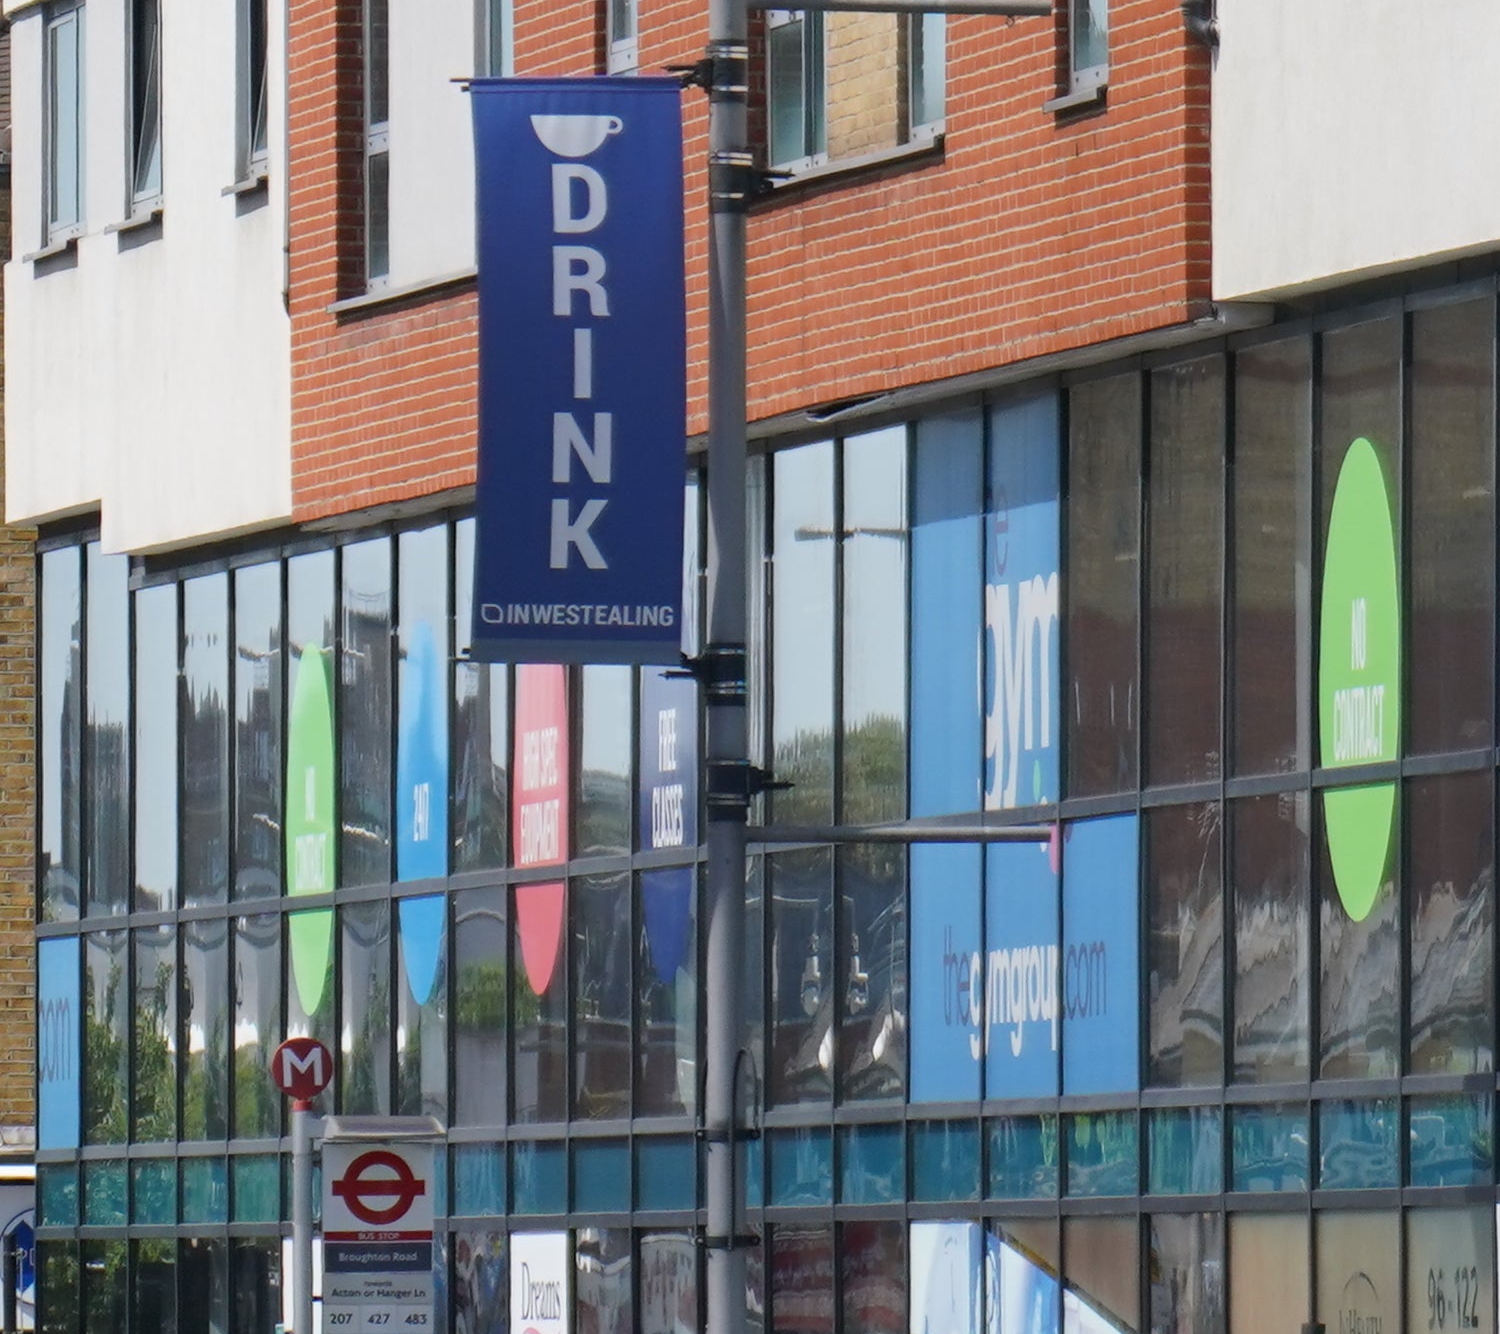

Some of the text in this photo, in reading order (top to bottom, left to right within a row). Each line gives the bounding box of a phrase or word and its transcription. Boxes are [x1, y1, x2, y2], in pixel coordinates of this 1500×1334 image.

[550, 163, 613, 569] DRINK
[507, 604, 674, 627] INWESTEALING
[1334, 684, 1384, 761] CONTRACT
[282, 1046, 323, 1087] M
[378, 1232, 399, 1240] STOP
[339, 1251, 418, 1263] Broughton Road
[331, 1288, 361, 1298] Acton
[377, 1288, 411, 1299] Hanger
[414, 1288, 426, 1297] Ln
[521, 1262, 561, 1321] Dreams
[1427, 1267, 1479, 1330] 96 122
[330, 1314, 353, 1324] 207
[368, 1313, 390, 1324] 427
[405, 1313, 427, 1325] 483
